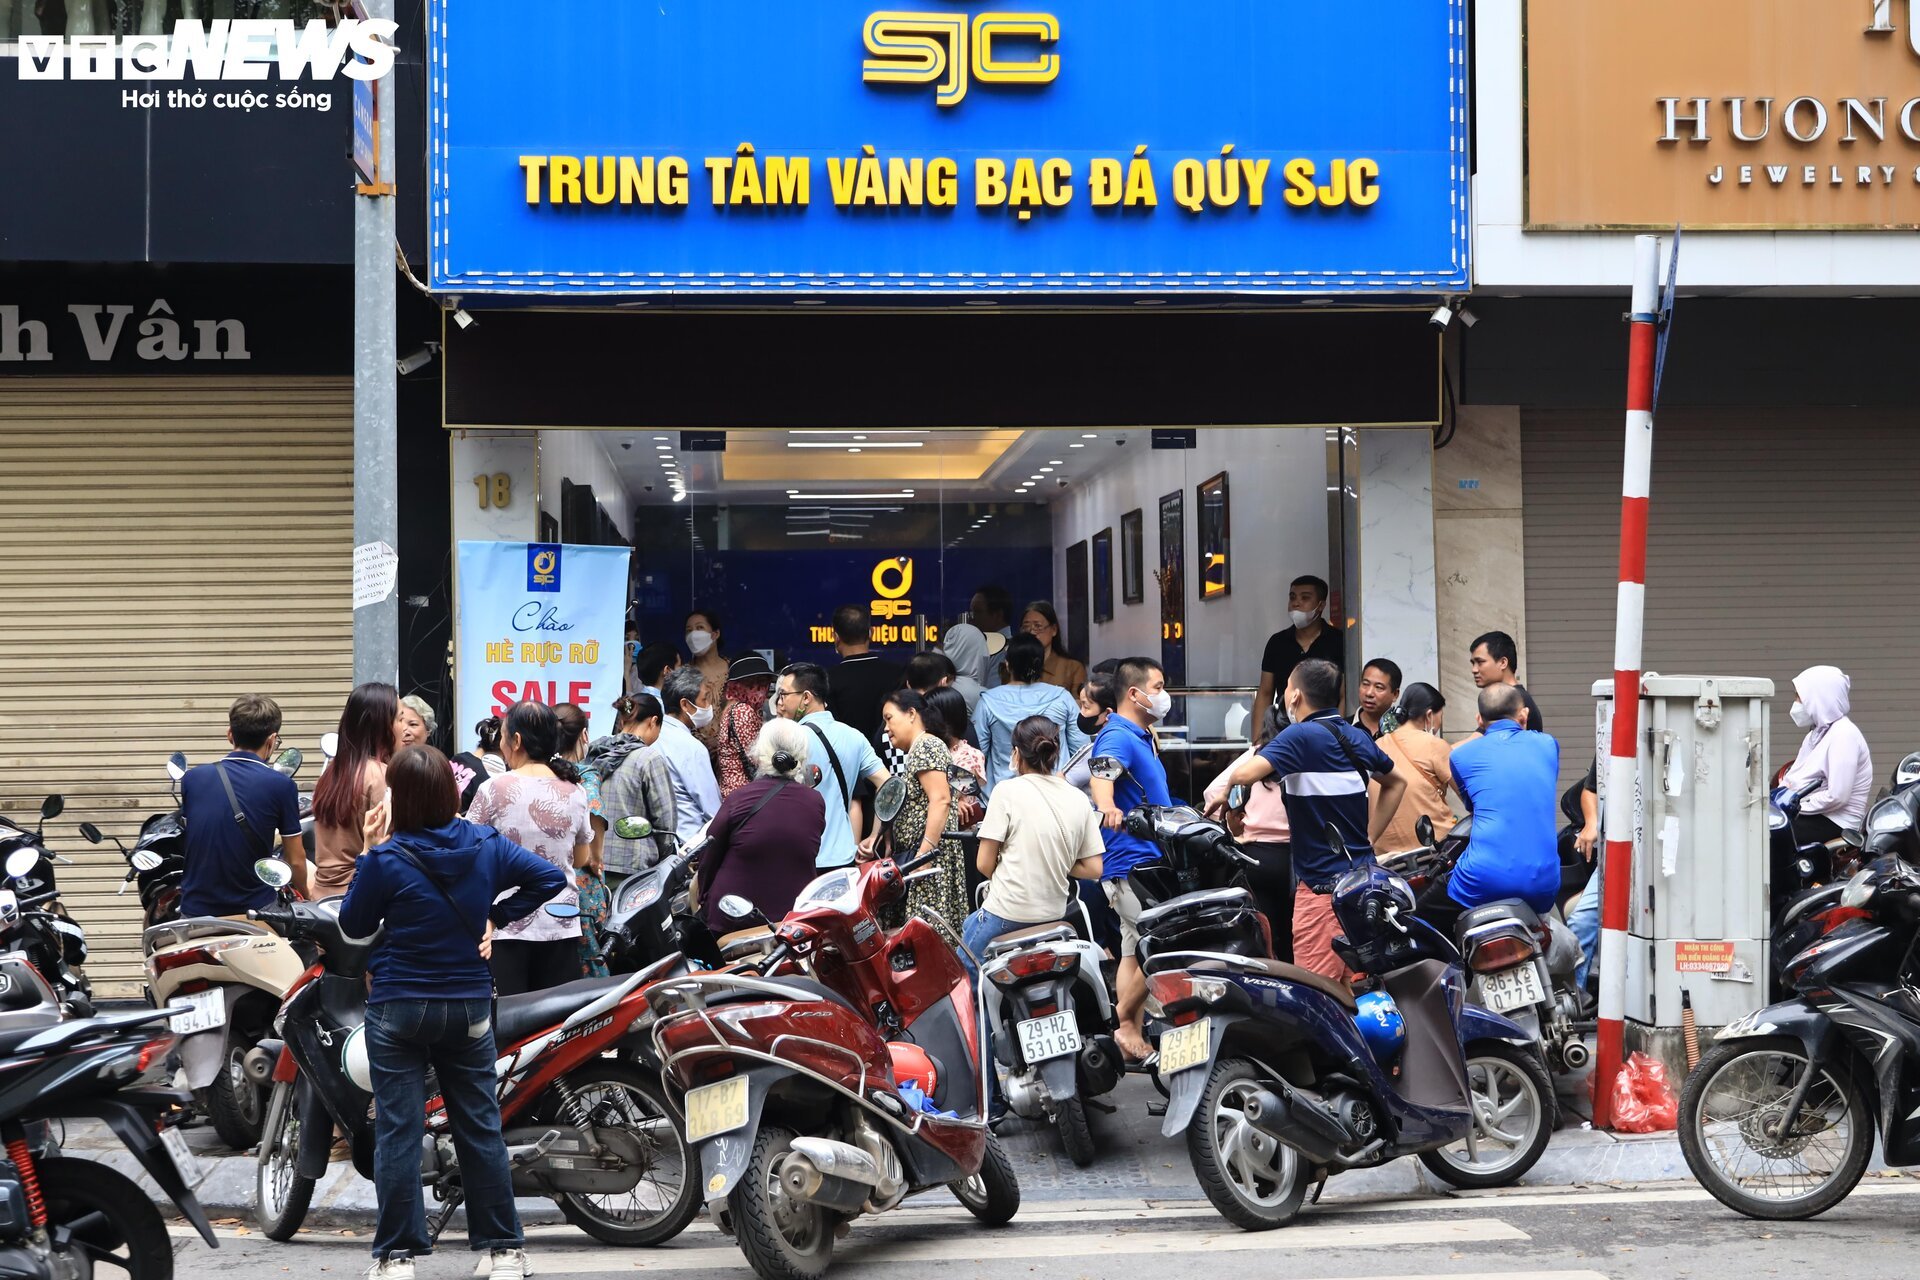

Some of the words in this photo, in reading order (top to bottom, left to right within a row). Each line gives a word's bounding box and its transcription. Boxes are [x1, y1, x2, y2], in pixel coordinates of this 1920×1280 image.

[862, 11, 1060, 107] SJC
[519, 156, 689, 206] TRUNG
[705, 143, 810, 206] TÂM
[827, 144, 958, 206] VÀNG
[975, 158, 1073, 220] BẠC
[1089, 144, 1158, 207] ĐÁ
[1173, 144, 1271, 213] QÚY
[1284, 158, 1381, 207] SJC
[1706, 165, 1896, 186] JEWELRY
[67, 299, 251, 361] Vân
[473, 472, 511, 510] 18
[512, 601, 575, 632] Chào
[870, 599, 912, 620] SJC
[486, 638, 515, 663] HÈ
[520, 640, 563, 667] RỰC
[568, 639, 600, 665] RỠ
[1473, 907, 1505, 919] HONDA
[1494, 985, 1536, 1009] 0775
[1026, 1015, 1067, 1040] 29-H2
[1026, 1032, 1077, 1059] 531.85
[1162, 1042, 1205, 1071] 356.61
